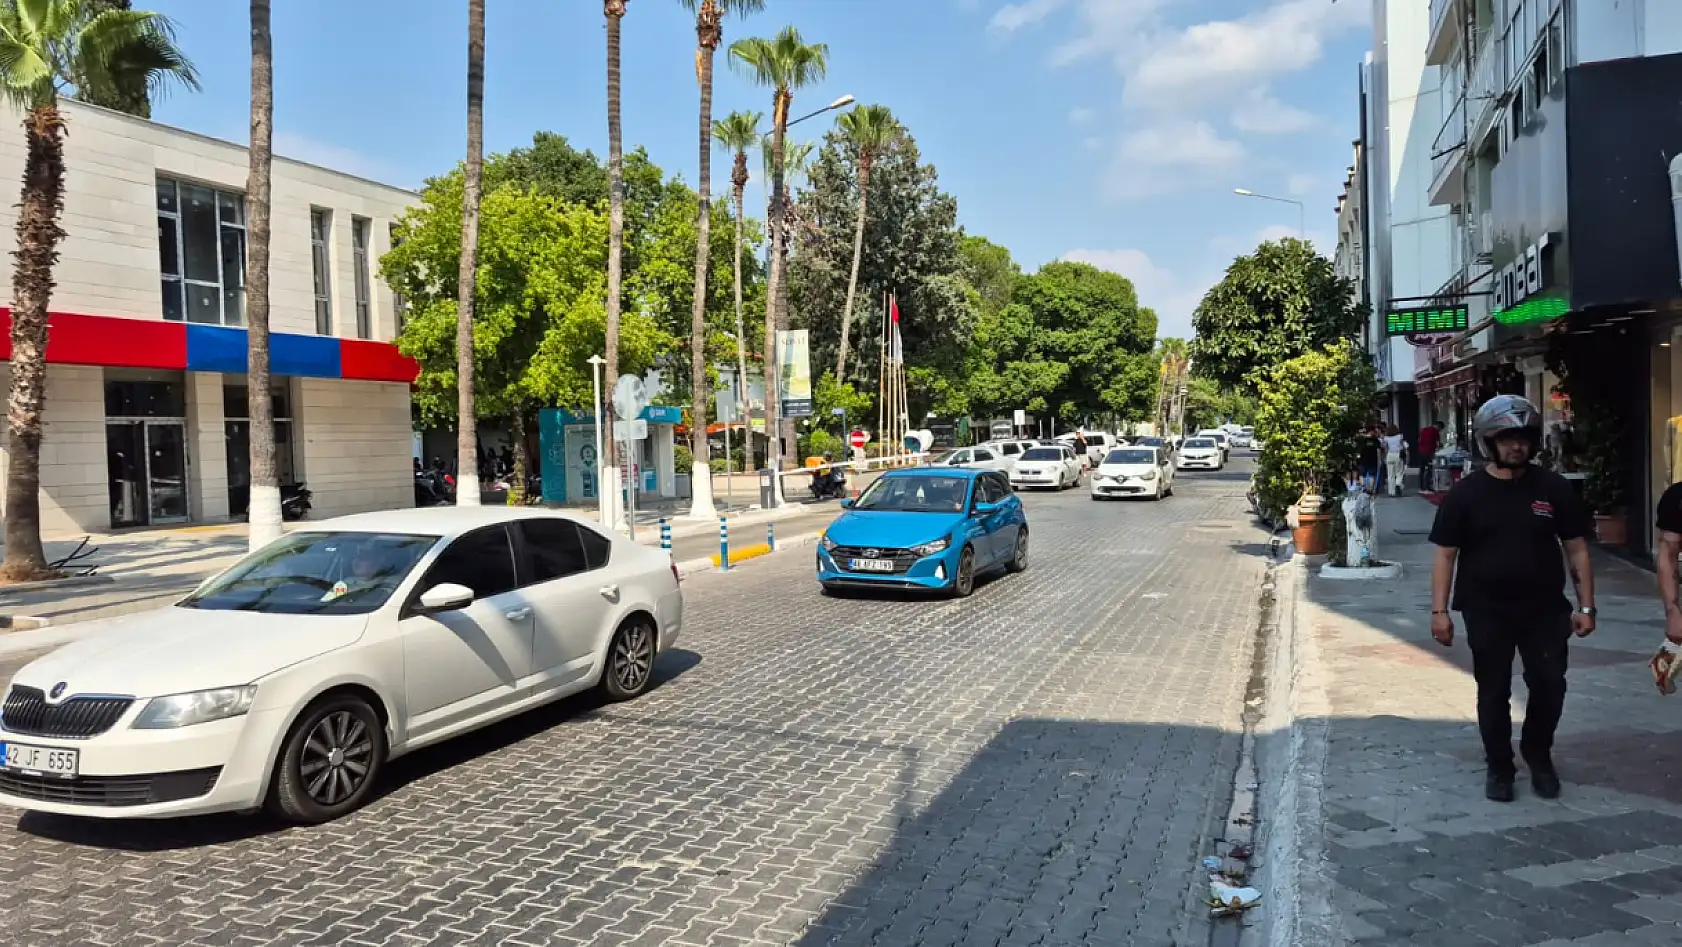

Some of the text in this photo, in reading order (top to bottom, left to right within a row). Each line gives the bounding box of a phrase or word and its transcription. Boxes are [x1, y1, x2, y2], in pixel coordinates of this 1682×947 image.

[6, 746, 74, 770] 42 JF 655
